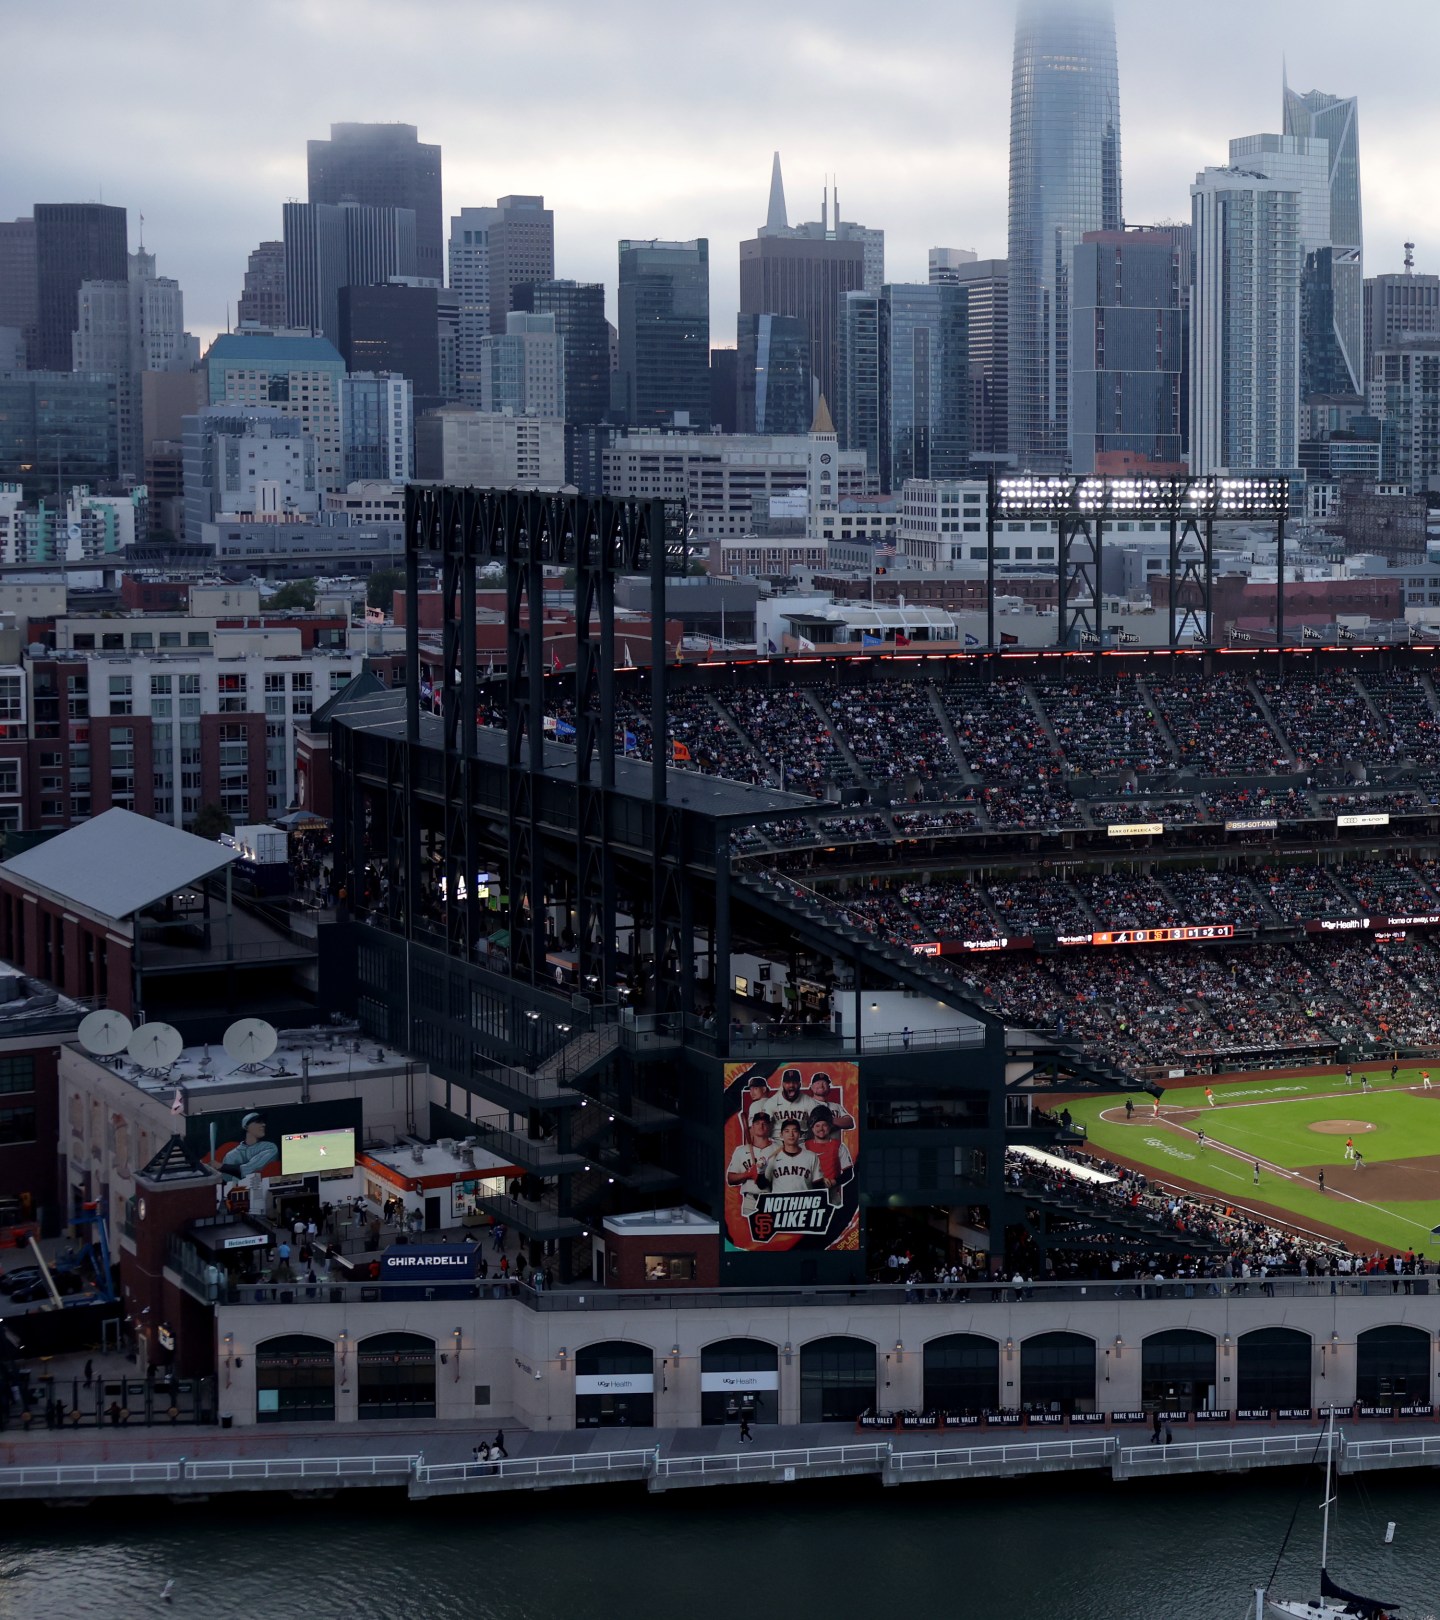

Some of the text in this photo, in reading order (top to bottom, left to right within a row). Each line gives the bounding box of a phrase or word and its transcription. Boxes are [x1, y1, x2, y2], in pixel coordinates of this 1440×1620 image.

[1336, 919, 1359, 928] Health
[1388, 917, 1405, 925] Home
[1136, 932, 1144, 940] 0
[1173, 930, 1181, 938] 3
[976, 939, 998, 948] Health
[773, 1166, 811, 1180] GIANTS
[763, 1196, 822, 1214] NOTHING
[773, 1208, 826, 1229] LIKE IT
[755, 1214, 773, 1239] SF
[228, 1238, 256, 1248] Heineken
[387, 1256, 468, 1267] GHIRARDELLI
[611, 1380, 633, 1388] Health
[736, 1377, 757, 1385] Health
